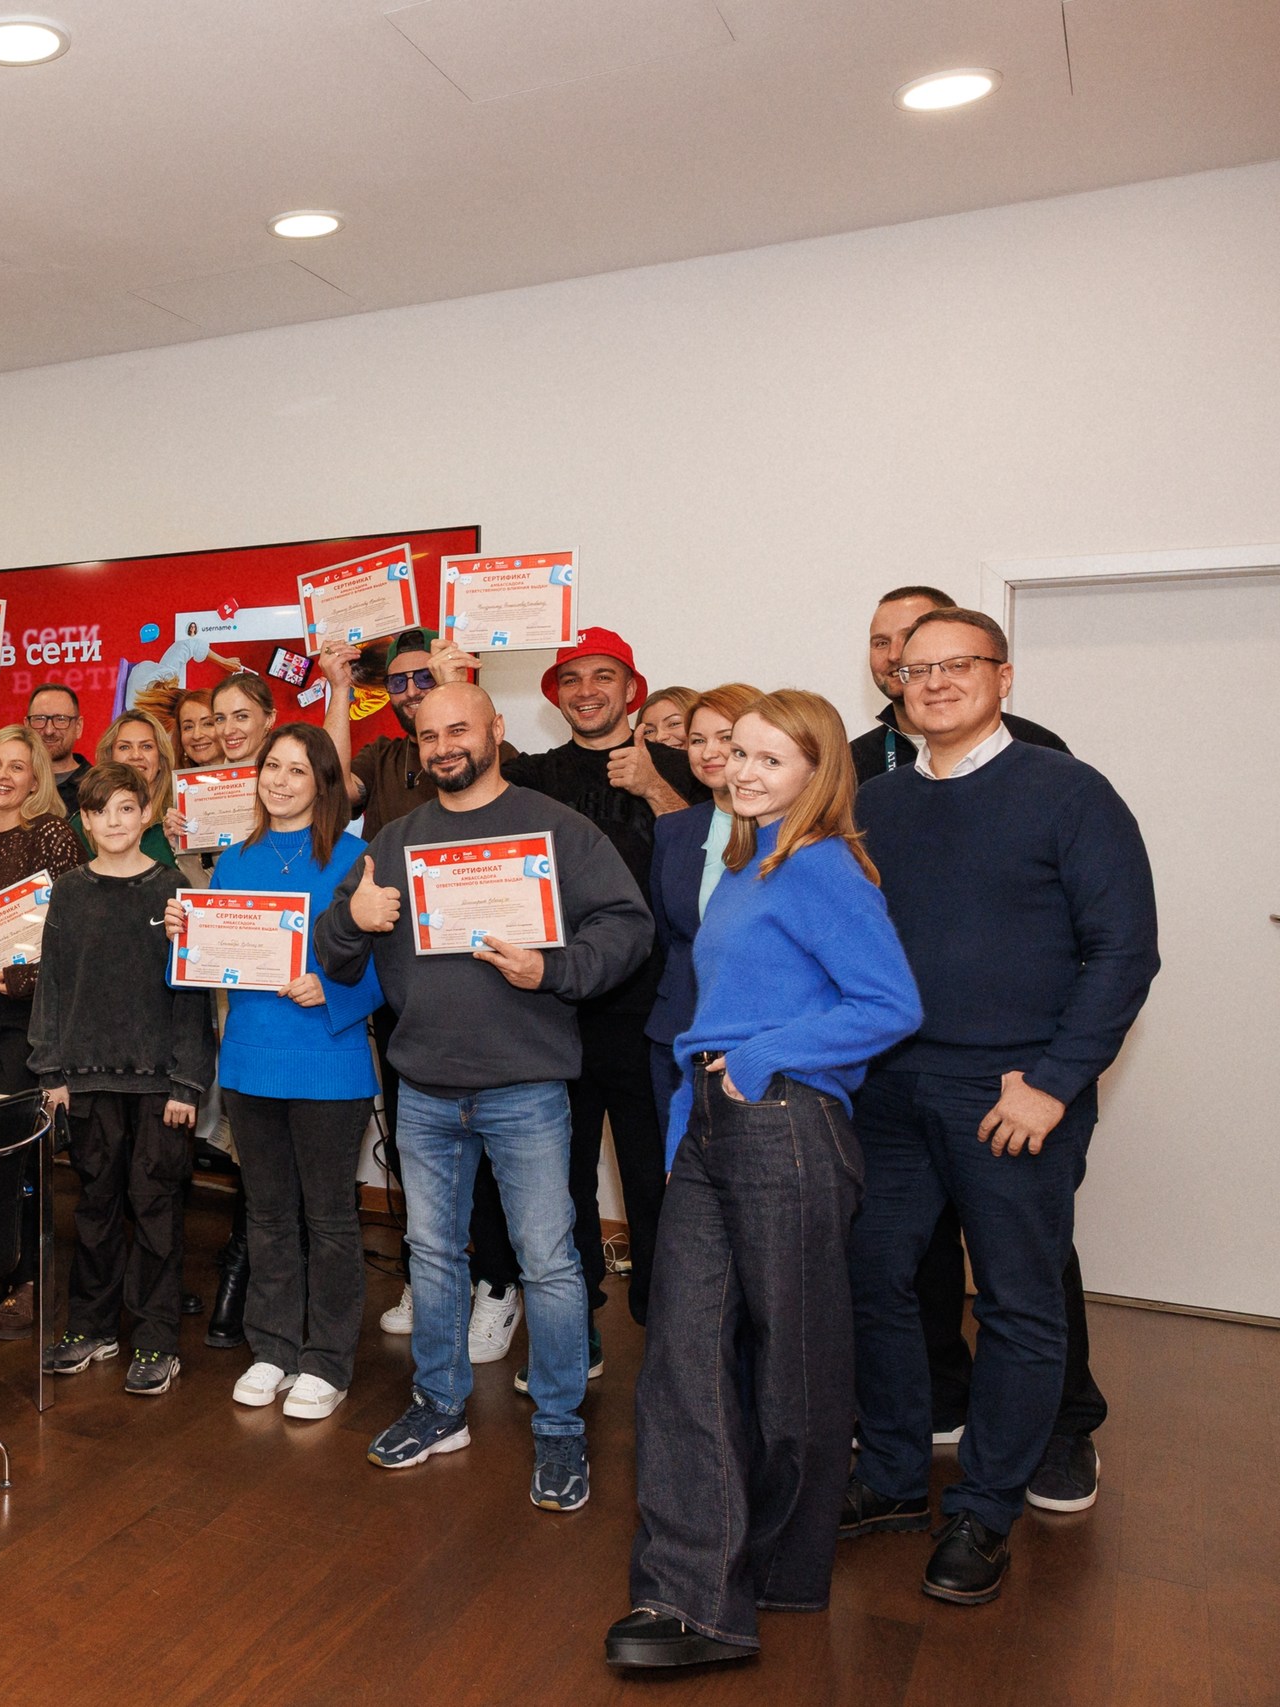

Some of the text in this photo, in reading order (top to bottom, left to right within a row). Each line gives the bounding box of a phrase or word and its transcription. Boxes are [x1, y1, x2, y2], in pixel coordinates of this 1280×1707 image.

[483, 573, 530, 582] СЕРТИФИКАТ
[333, 575, 372, 591] СЕРТИФИКАТ
[202, 624, 232, 632] username
[26, 639, 102, 666] сети
[207, 782, 246, 792] СЕРТИФИКАТ
[452, 864, 502, 876] СЕРТИФИКАТ
[216, 912, 262, 920] СЕРТИФИКАТ
